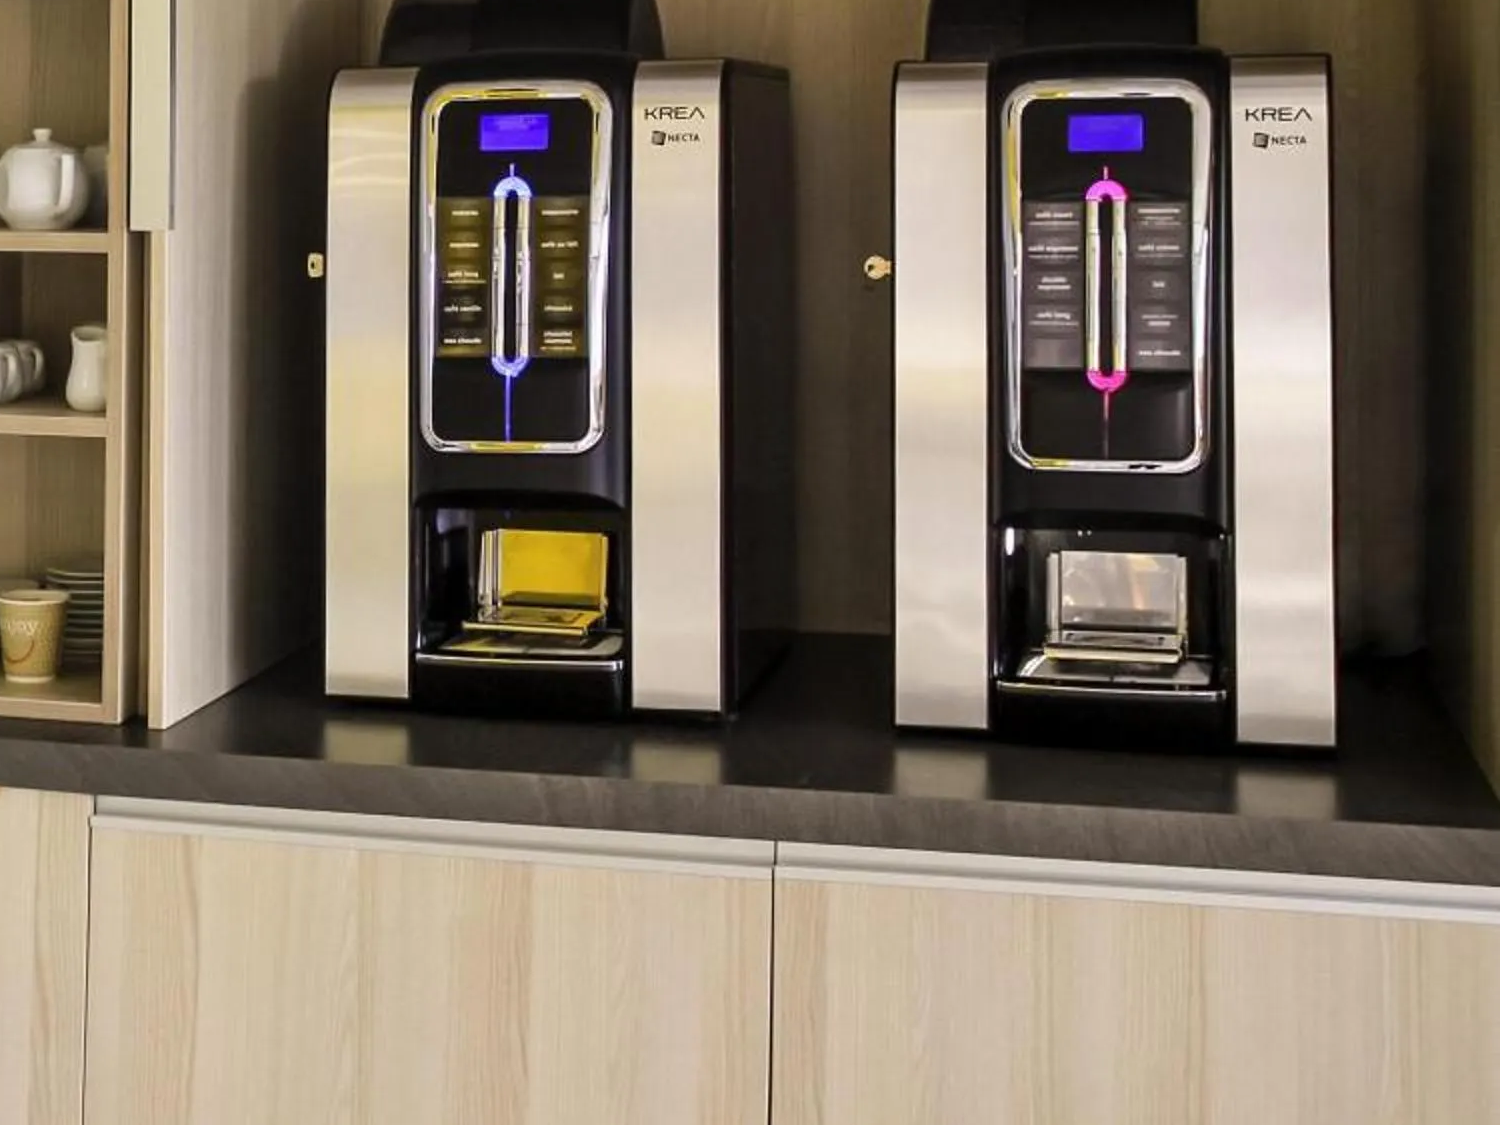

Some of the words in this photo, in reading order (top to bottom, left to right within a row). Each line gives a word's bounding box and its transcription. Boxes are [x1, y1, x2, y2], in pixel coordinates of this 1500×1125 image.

[644, 106, 705, 120] KREA
[1245, 107, 1312, 121] KREA
[668, 134, 700, 142] NECTA
[1271, 135, 1307, 145] NECTA
